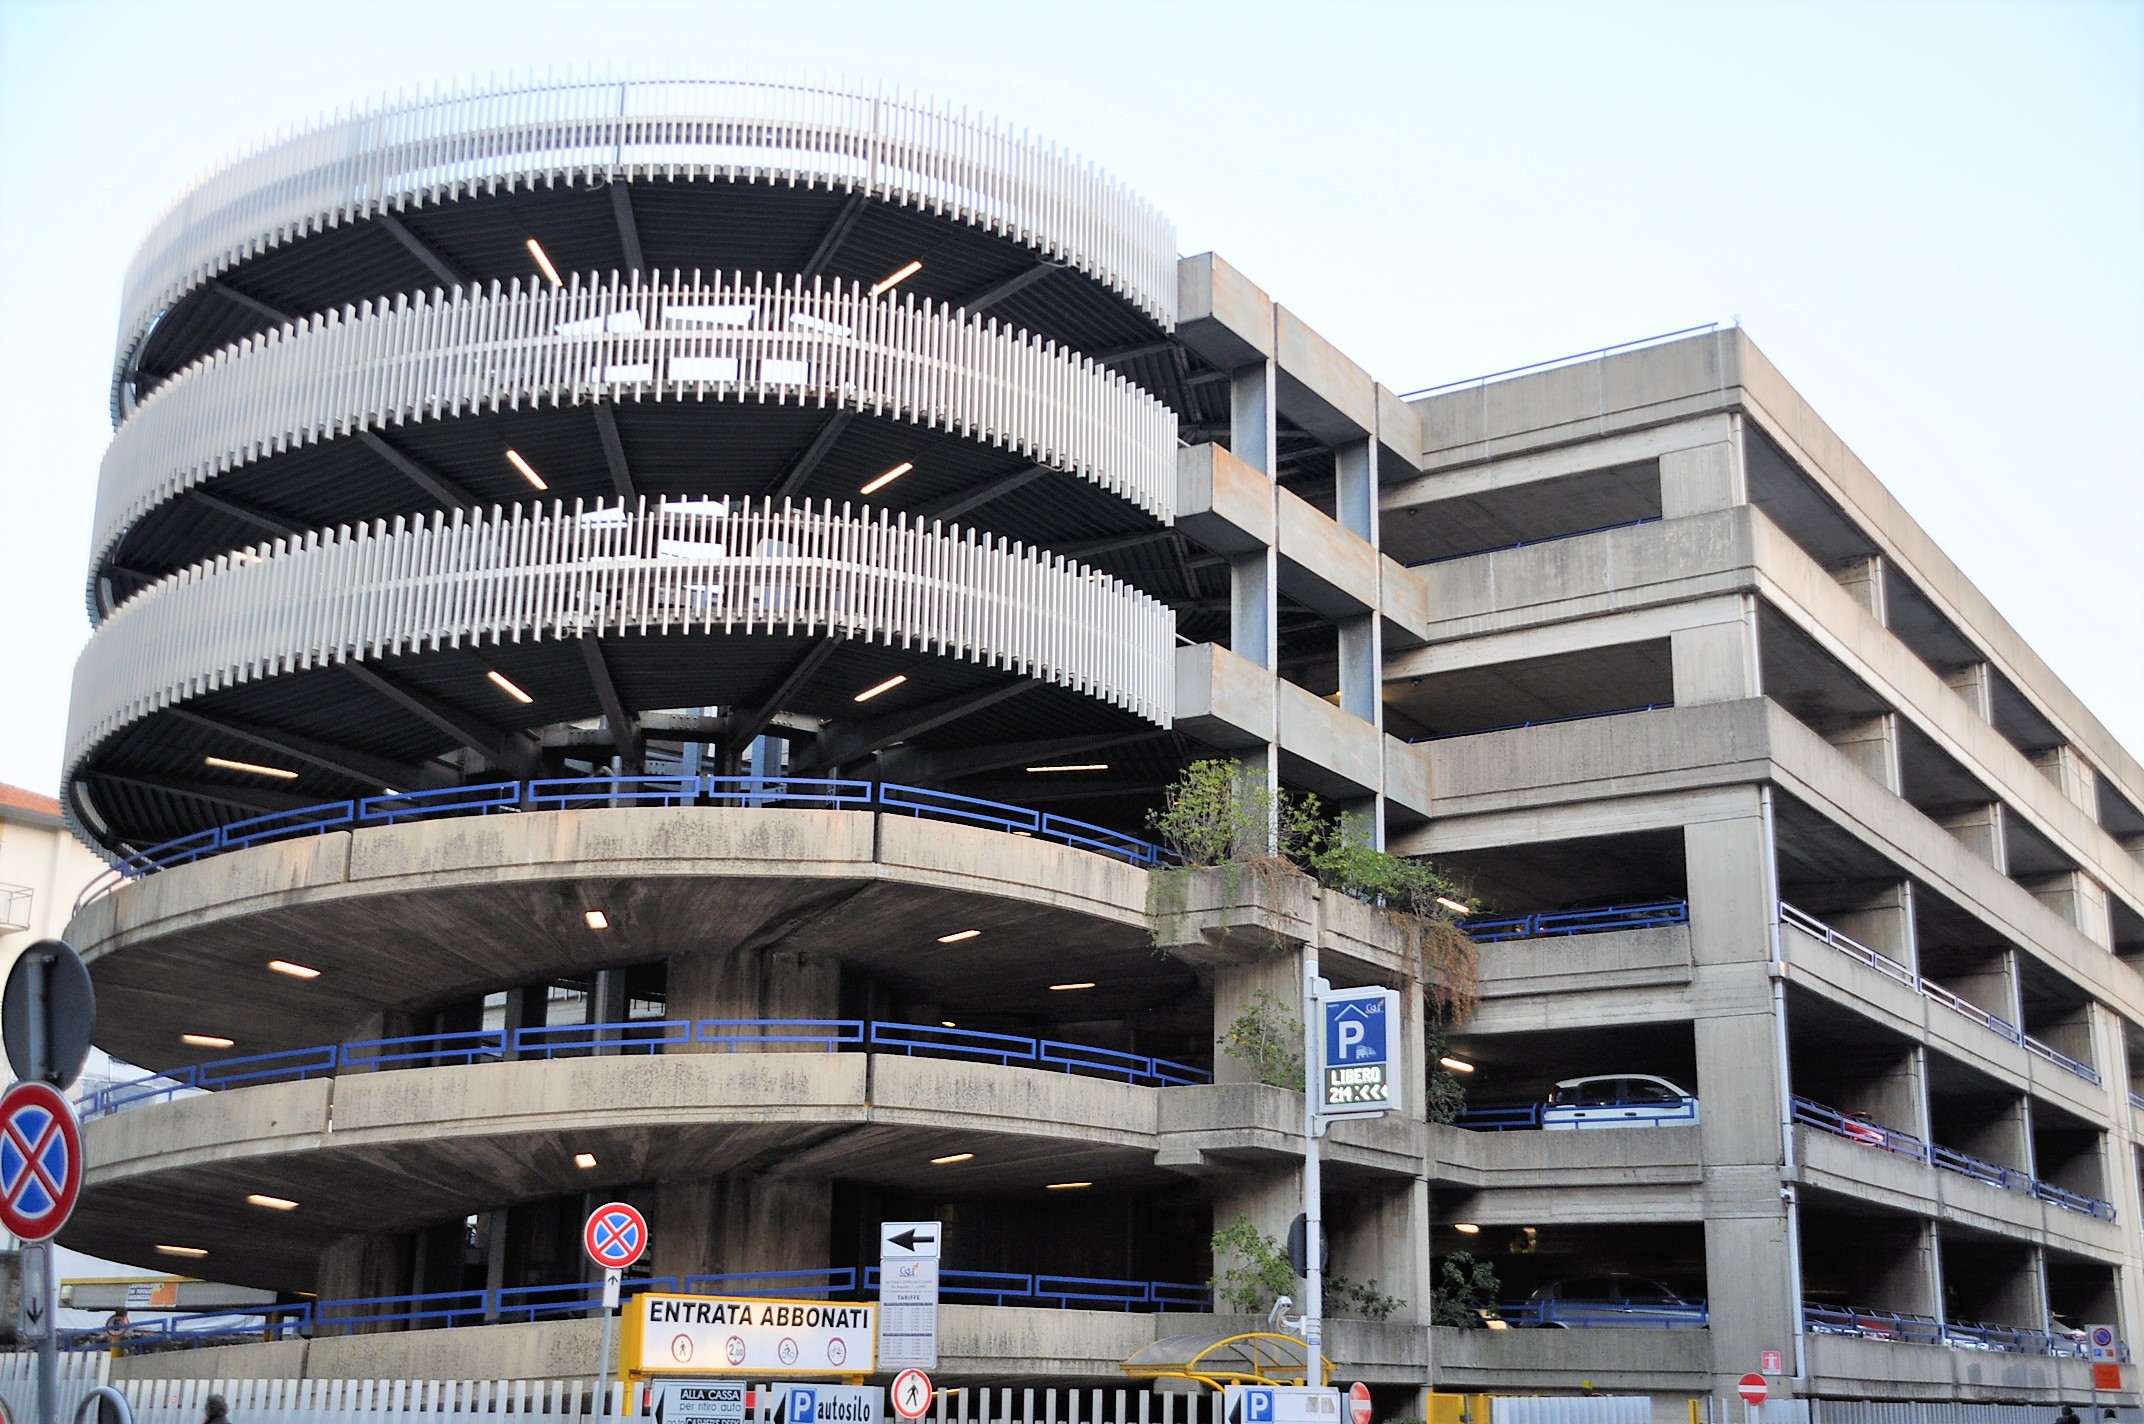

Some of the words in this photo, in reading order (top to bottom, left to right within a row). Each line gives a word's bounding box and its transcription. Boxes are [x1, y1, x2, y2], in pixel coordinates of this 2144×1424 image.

[1338, 1020, 1364, 1059] P
[1331, 1066, 1381, 1086] LIBERO
[1329, 1085, 1353, 1104] 214
[650, 1300, 753, 1325] ENTRATA
[760, 1305, 868, 1329] ABBONATI
[680, 1402, 695, 1412] per
[698, 1402, 717, 1411] ritiro
[721, 1402, 741, 1412] auto
[682, 1389, 705, 1400] ALLA
[708, 1389, 740, 1401] CASSA
[793, 1391, 812, 1421] P
[817, 1395, 871, 1422] autosilo
[1250, 1392, 1269, 1420] P
